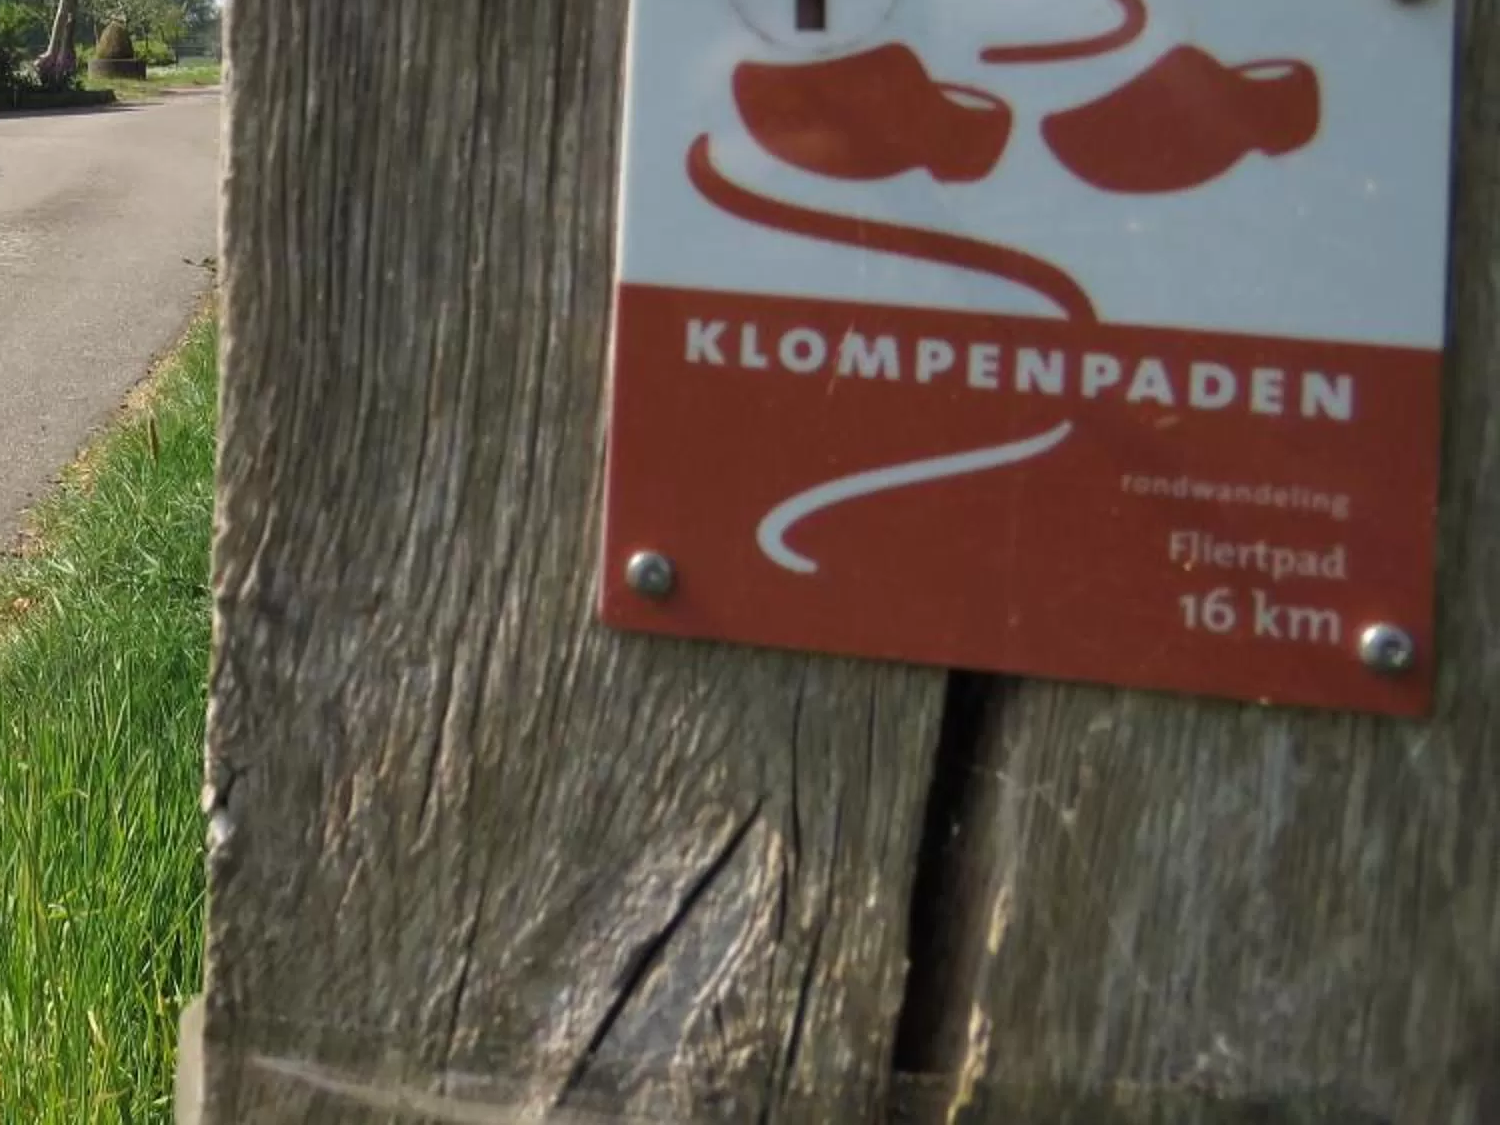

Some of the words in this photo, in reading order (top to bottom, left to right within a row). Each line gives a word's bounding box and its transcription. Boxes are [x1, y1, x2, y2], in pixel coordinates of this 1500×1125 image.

[684, 320, 1354, 421] KLOMPENPADEN
[1120, 473, 1350, 520] rondwandeling
[1168, 530, 1347, 582] Fliertpad
[1179, 586, 1237, 633] 16
[1251, 588, 1341, 645] km
